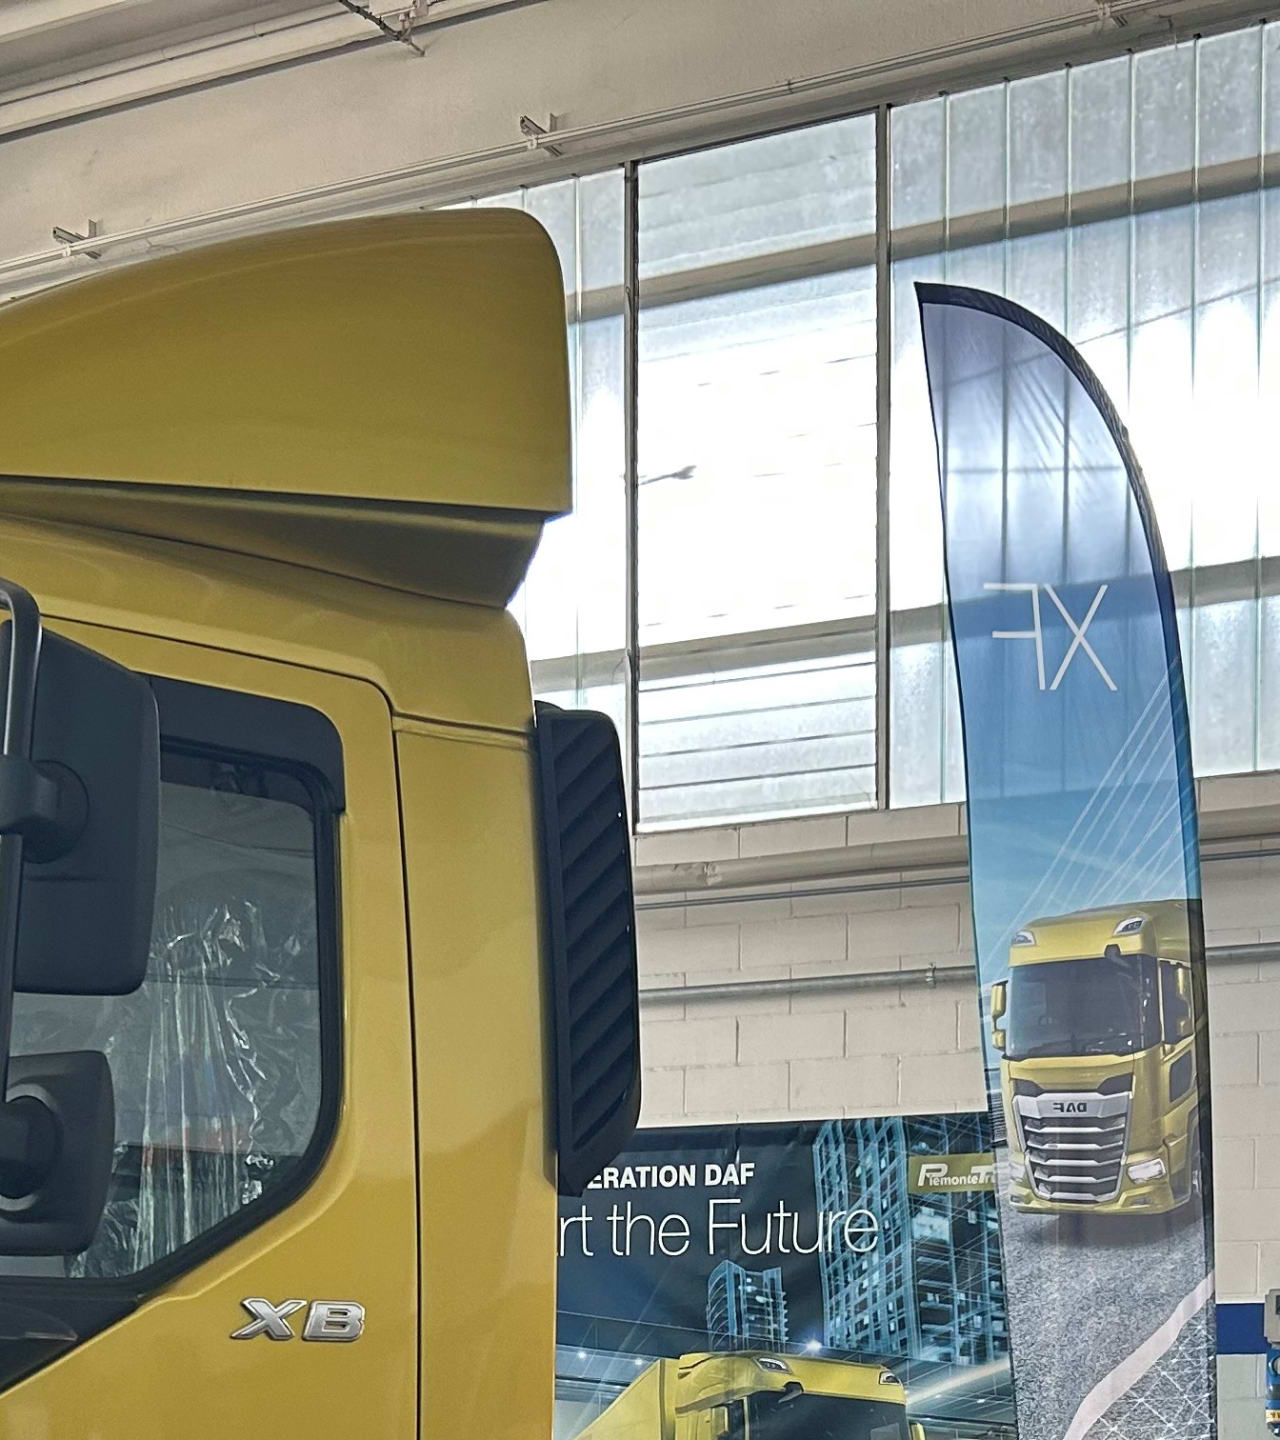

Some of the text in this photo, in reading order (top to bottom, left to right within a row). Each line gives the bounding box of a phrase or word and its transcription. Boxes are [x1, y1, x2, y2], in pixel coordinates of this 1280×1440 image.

[704, 1162, 755, 1187] DAF
[606, 1200, 691, 1257] the
[708, 1198, 879, 1256] Future
[229, 1296, 366, 1343] XB
